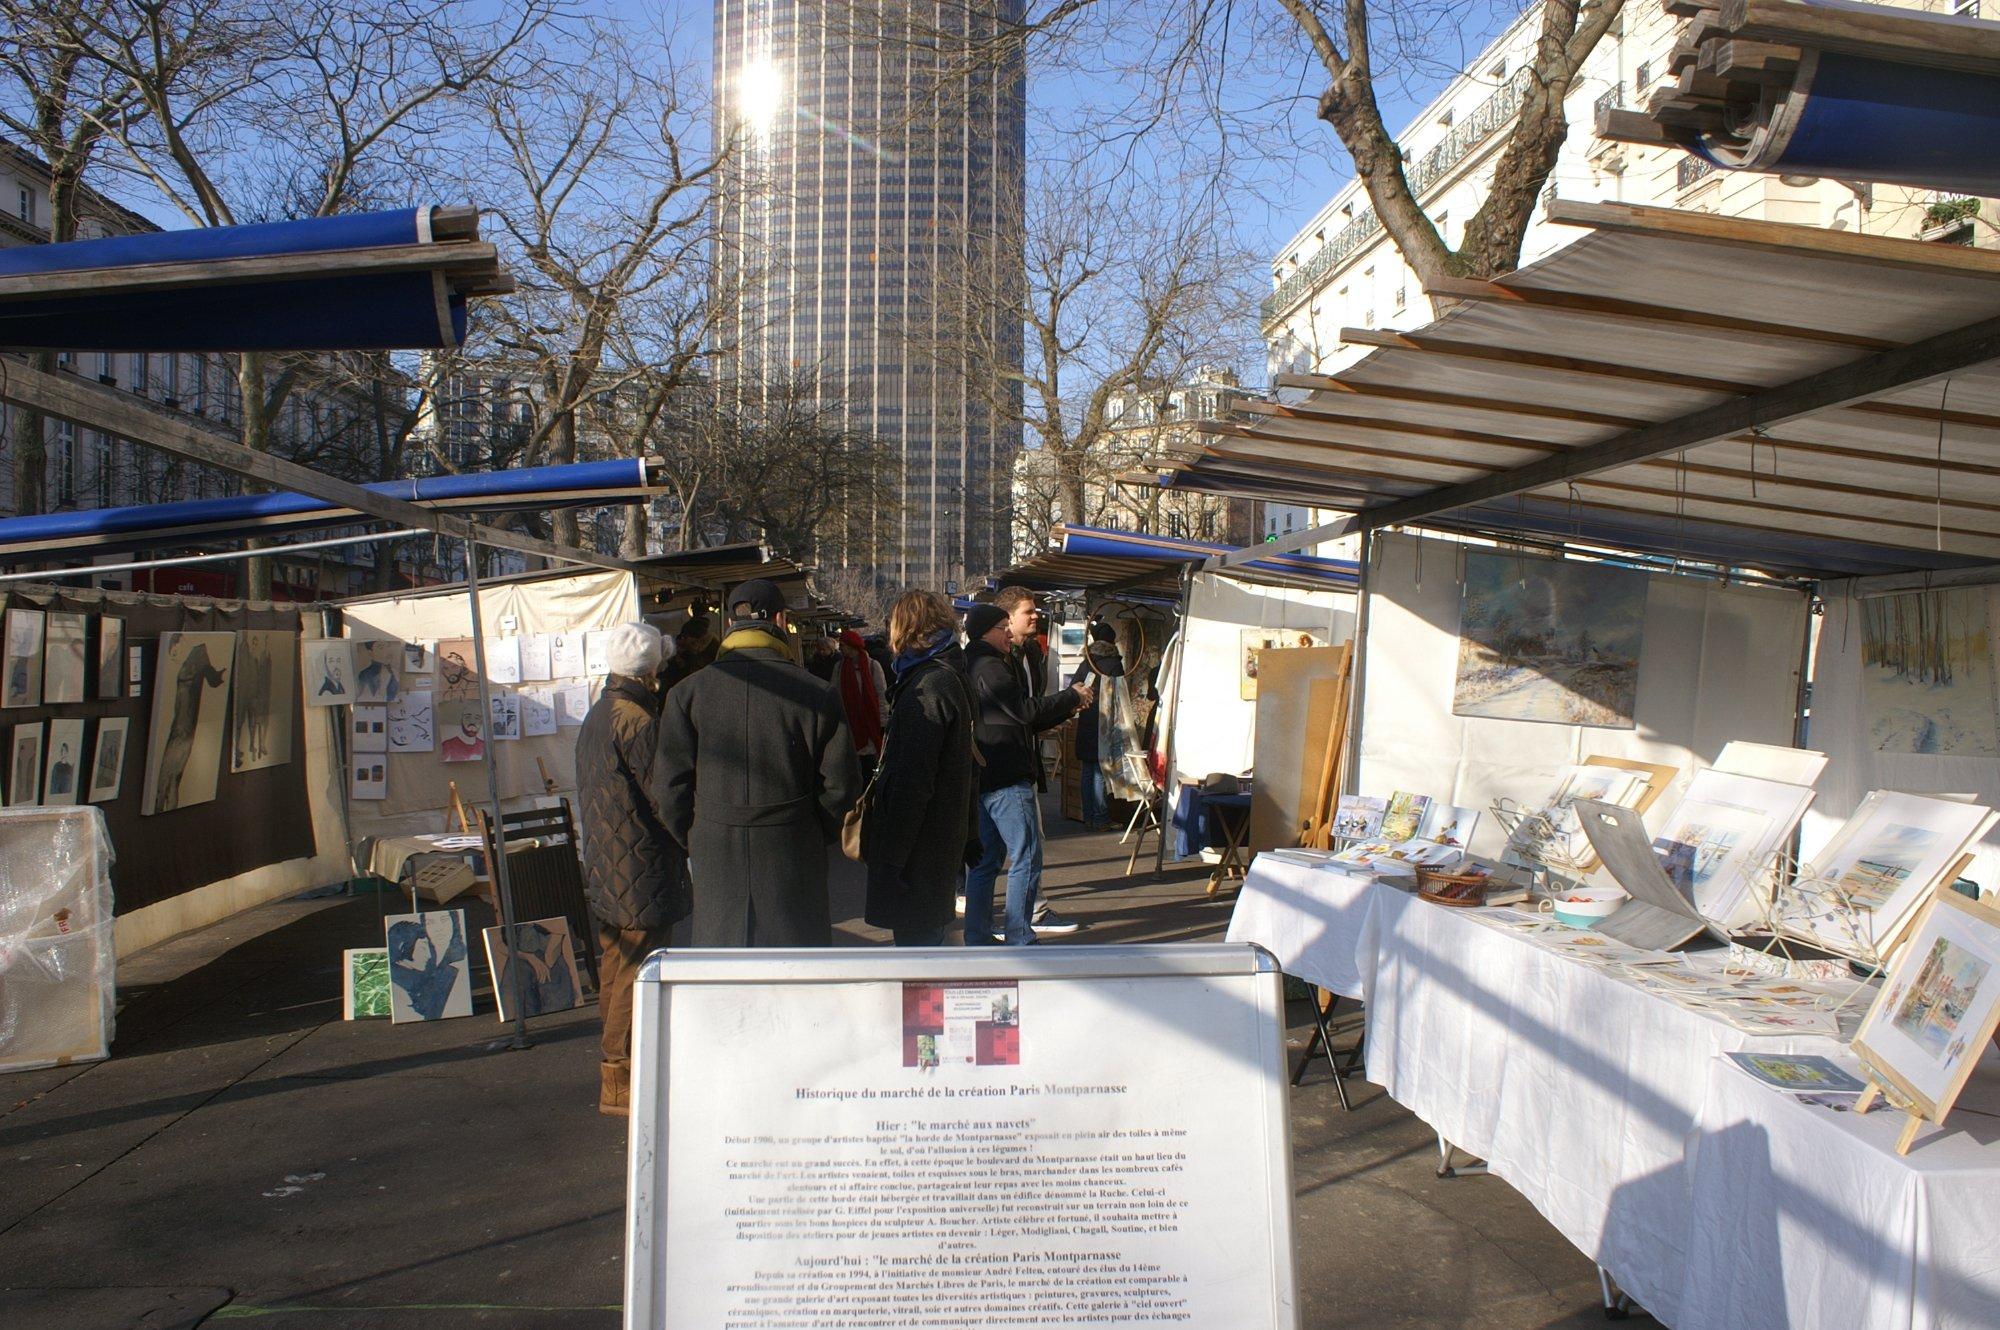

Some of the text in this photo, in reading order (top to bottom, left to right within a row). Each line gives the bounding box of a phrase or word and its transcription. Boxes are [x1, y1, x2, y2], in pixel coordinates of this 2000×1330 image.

[795, 1083, 1128, 1103] Historique du marché de la création Paris Montparnasse
[876, 1121, 901, 1131] Hier
[910, 1120, 927, 1131] "le
[929, 1119, 970, 1130] marché
[995, 1118, 1037, 1129] navets"
[823, 1129, 1151, 1145] d'artistes baptisé horde Montparnasse" exposait toiles
[927, 1145, 967, 1154] l'allusion
[992, 1143, 1027, 1155] légumes
[832, 1159, 862, 1168] succès.
[879, 1158, 901, 1168] effet,
[933, 1157, 964, 1168] époque
[976, 1156, 1020, 1165] boulevard
[1035, 1154, 1098, 1166] Montparnasse
[1099, 1154, 1119, 1162] était
[1134, 1153, 1155, 1162] haut
[1156, 1152, 1173, 1161] lieu
[817, 1170, 849, 1180] artistes
[851, 1170, 891, 1180] venaient,
[892, 1169, 915, 1178] toiles
[927, 1168, 967, 1179] esquisses
[999, 1167, 1022, 1177] bras,
[1023, 1166, 1077, 1175] marchander
[1078, 1165, 1099, 1174] dans
[1101, 1165, 1113, 1174] les
[1115, 1164, 1159, 1174] nombreux
[1161, 1164, 1183, 1173] cafés
[848, 1182, 877, 1191] affaire
[879, 1182, 915, 1192] conclue,
[916, 1180, 972, 1192] partageaient
[973, 1180, 992, 1189] leur
[993, 1182, 1018, 1191] repas
[1041, 1179, 1053, 1188] les
[1055, 1178, 1082, 1187] moins
[1083, 1177, 1127, 1187] chanceux.
[808, 1188, 1166, 1204] cette horde était hébergée travaillait dans édifice dénommé Ruche. Celui-ci
[816, 1208, 833, 1217] par
[847, 1205, 871, 1214] Eiffel
[873, 1207, 895, 1216] pour
[896, 1204, 947, 1216] l'exposition
[948, 1203, 999, 1214] universelle)
[1001, 1203, 1014, 1211] fut
[1016, 1202, 1064, 1211] reconstruit
[1096, 1200, 1127, 1209] terrain
[1147, 1200, 1164, 1208] loin
[831, 1212, 1170, 1229] hospices sculpteur Boucher. Artiste célèbre fortuné, souhaita mettre
[835, 1223, 1178, 1241] pour jeunes artistes devenir Léger, Modigliani, Chagall, Soutine, bien
[938, 1240, 976, 1249] d'autres.
[795, 1255, 862, 1270] Aujourd'hui
[872, 1255, 889, 1265] "le
[891, 1254, 932, 1265] marché
[935, 1254, 948, 1264] de
[950, 1253, 961, 1264] la
[964, 1252, 1009, 1264] création
[1011, 1252, 1040, 1263] Paris
[1043, 1251, 1121, 1265] Montparnasse
[848, 1269, 872, 1279] 1994,
[881, 1268, 926, 1277] l'initiative
[941, 1267, 983, 1276] monsieur
[984, 1266, 1013, 1275] André
[1014, 1265, 1045, 1276] Felten,
[1046, 1265, 1080, 1274] entouré
[1082, 1264, 1097, 1273] des
[1132, 1263, 1161, 1272] 14ème
[820, 1275, 1181, 1293] Groupement des Marchés Libres Paris, marché création est comparable
[795, 1287, 1171, 1305] galerie exposant toutes les diversités artistiques peintures, gravures, sculptures,
[833, 1305, 890, 1317] marqueterie,
[892, 1304, 922, 1315] vitrail,
[924, 1304, 941, 1313] soie
[983, 1302, 1026, 1312] domaines
[1027, 1301, 1063, 1311] créatifs.
[1065, 1301, 1089, 1310] Cette
[1091, 1300, 1121, 1312] galerie
[1153, 1299, 1187, 1308] ouvert"
[848, 1319, 896, 1327] rencontrer
[921, 1316, 984, 1328] communiquer
[985, 1315, 1039, 1324] directement
[1062, 1314, 1075, 1323] les
[1076, 1313, 1109, 1322] artistes
[1110, 1315, 1133, 1324] pour
[1134, 1312, 1149, 1321] des
[1151, 1311, 1190, 1323] échanges
